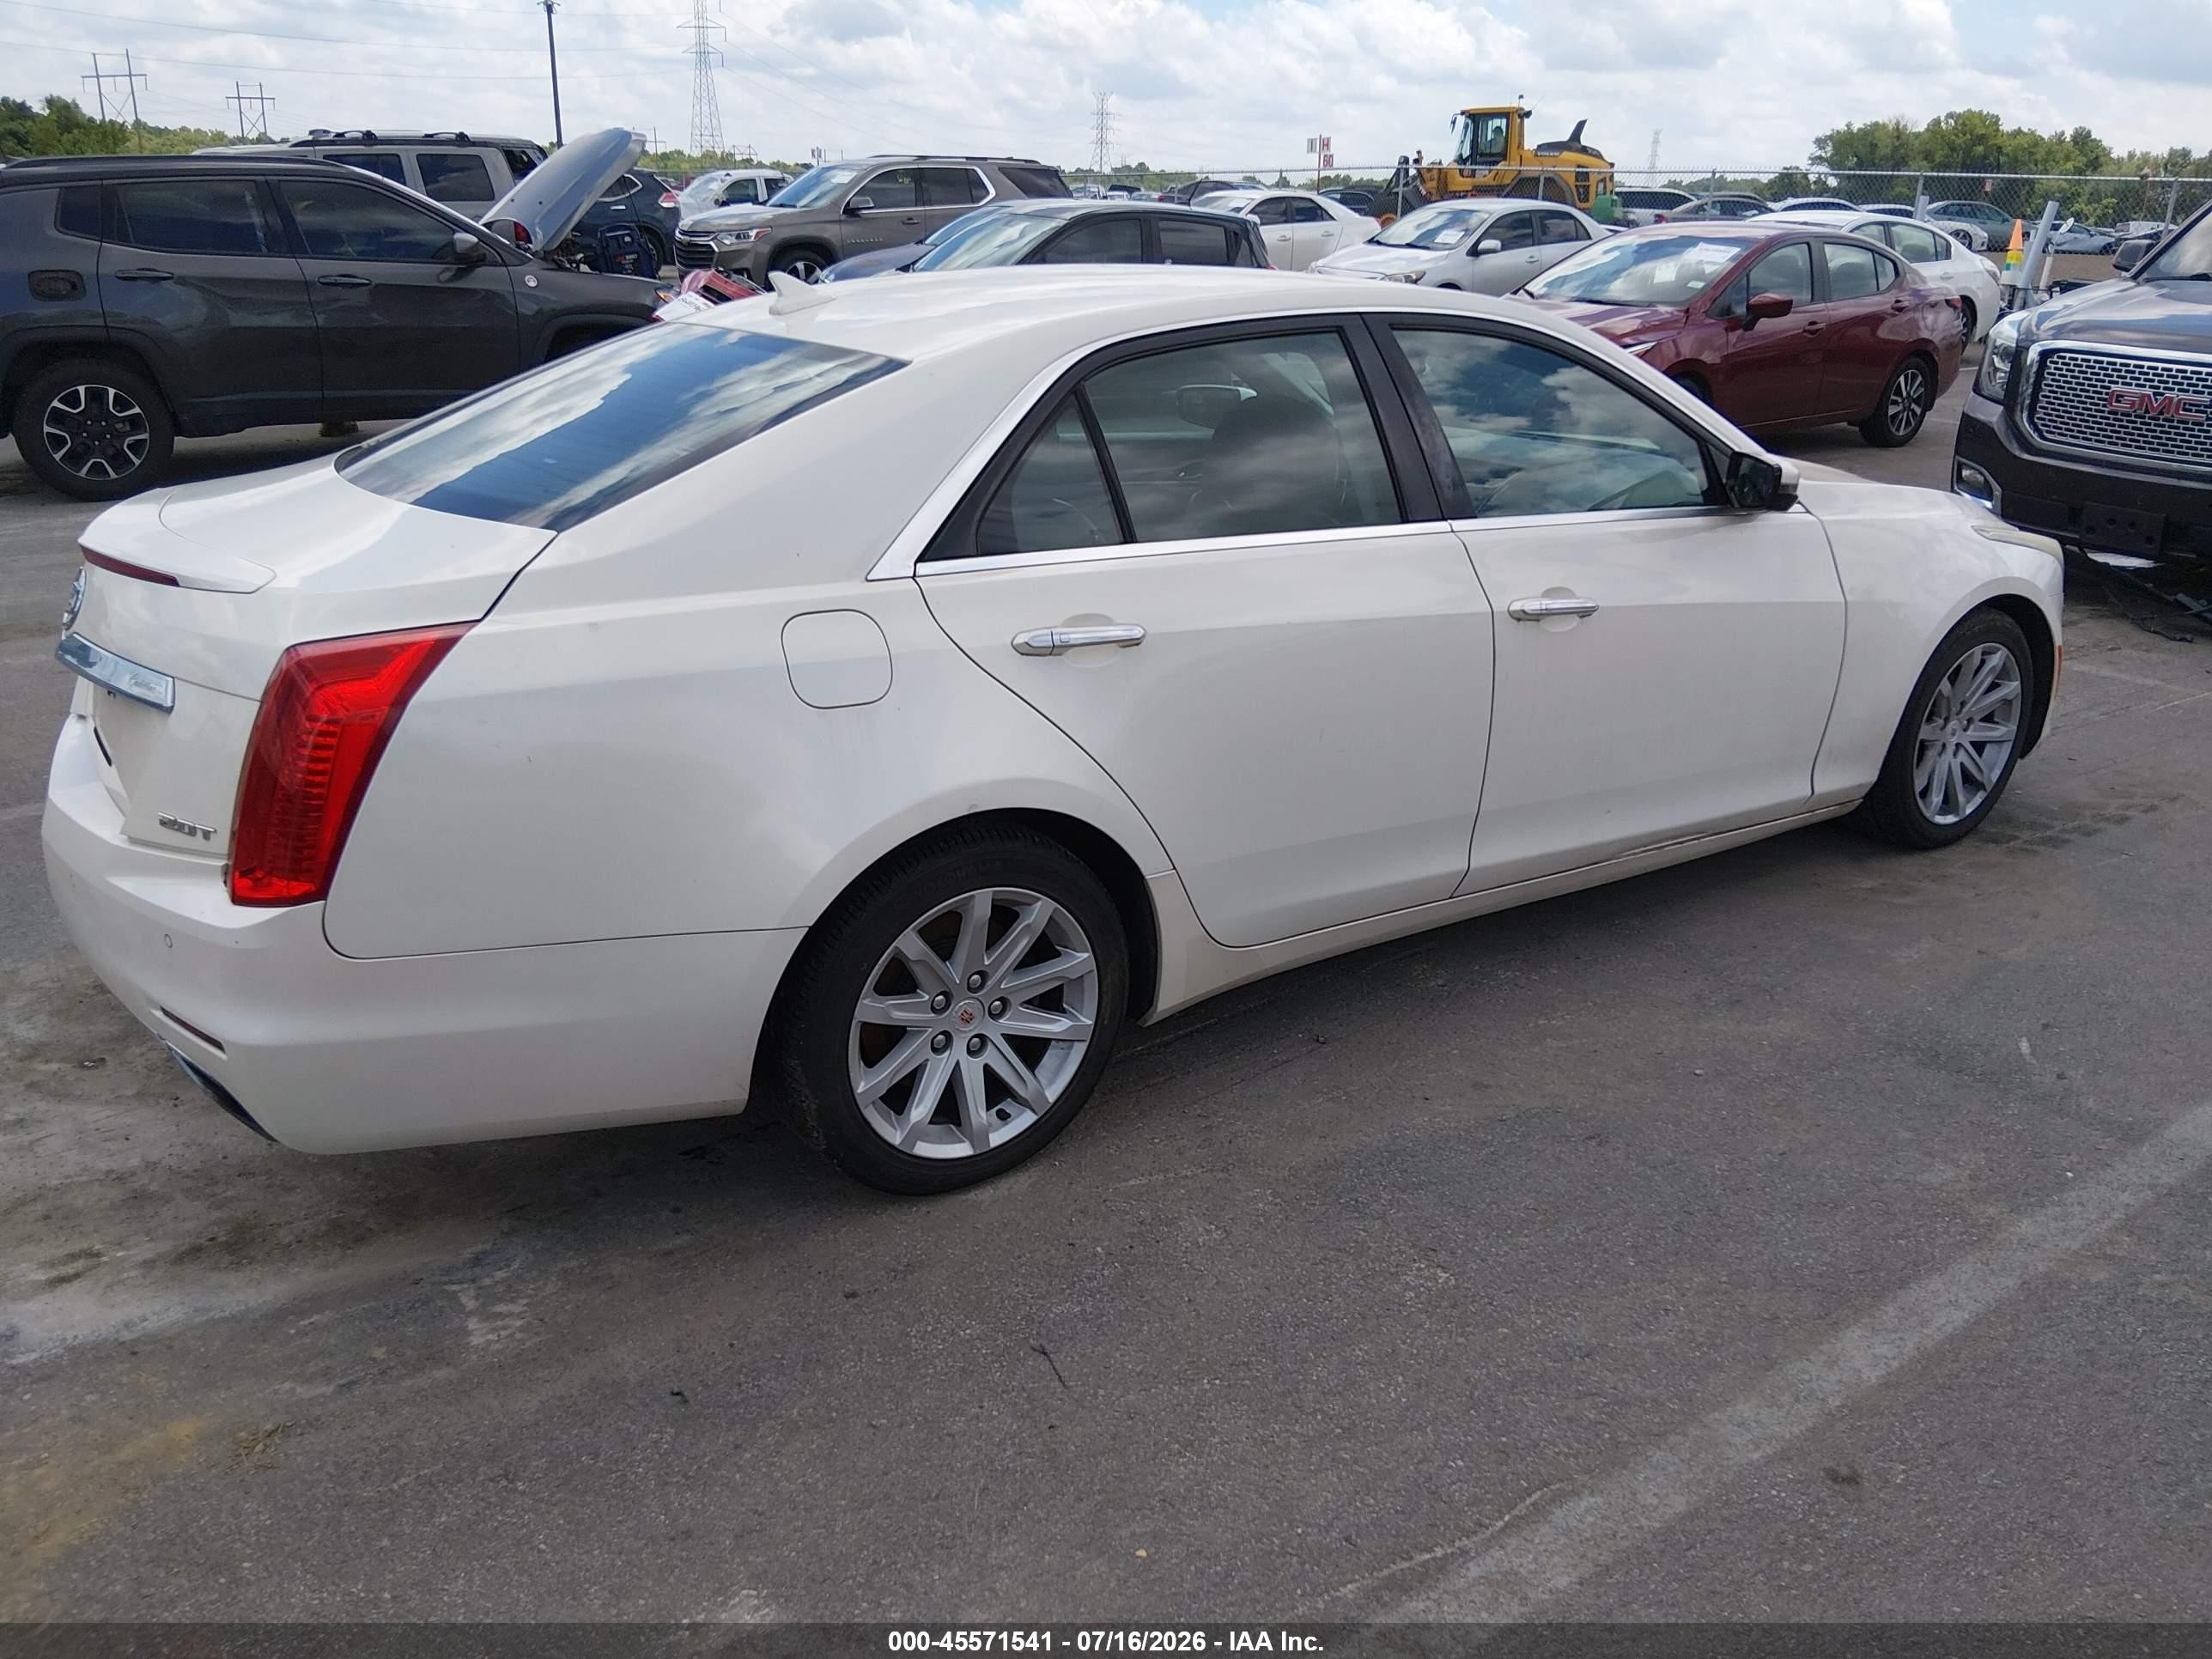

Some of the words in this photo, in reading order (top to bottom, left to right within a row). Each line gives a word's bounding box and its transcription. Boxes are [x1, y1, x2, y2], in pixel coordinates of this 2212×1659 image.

[1322, 137, 1329, 152] H
[1323, 155, 1334, 167] 60
[2107, 388, 2211, 422] GMC
